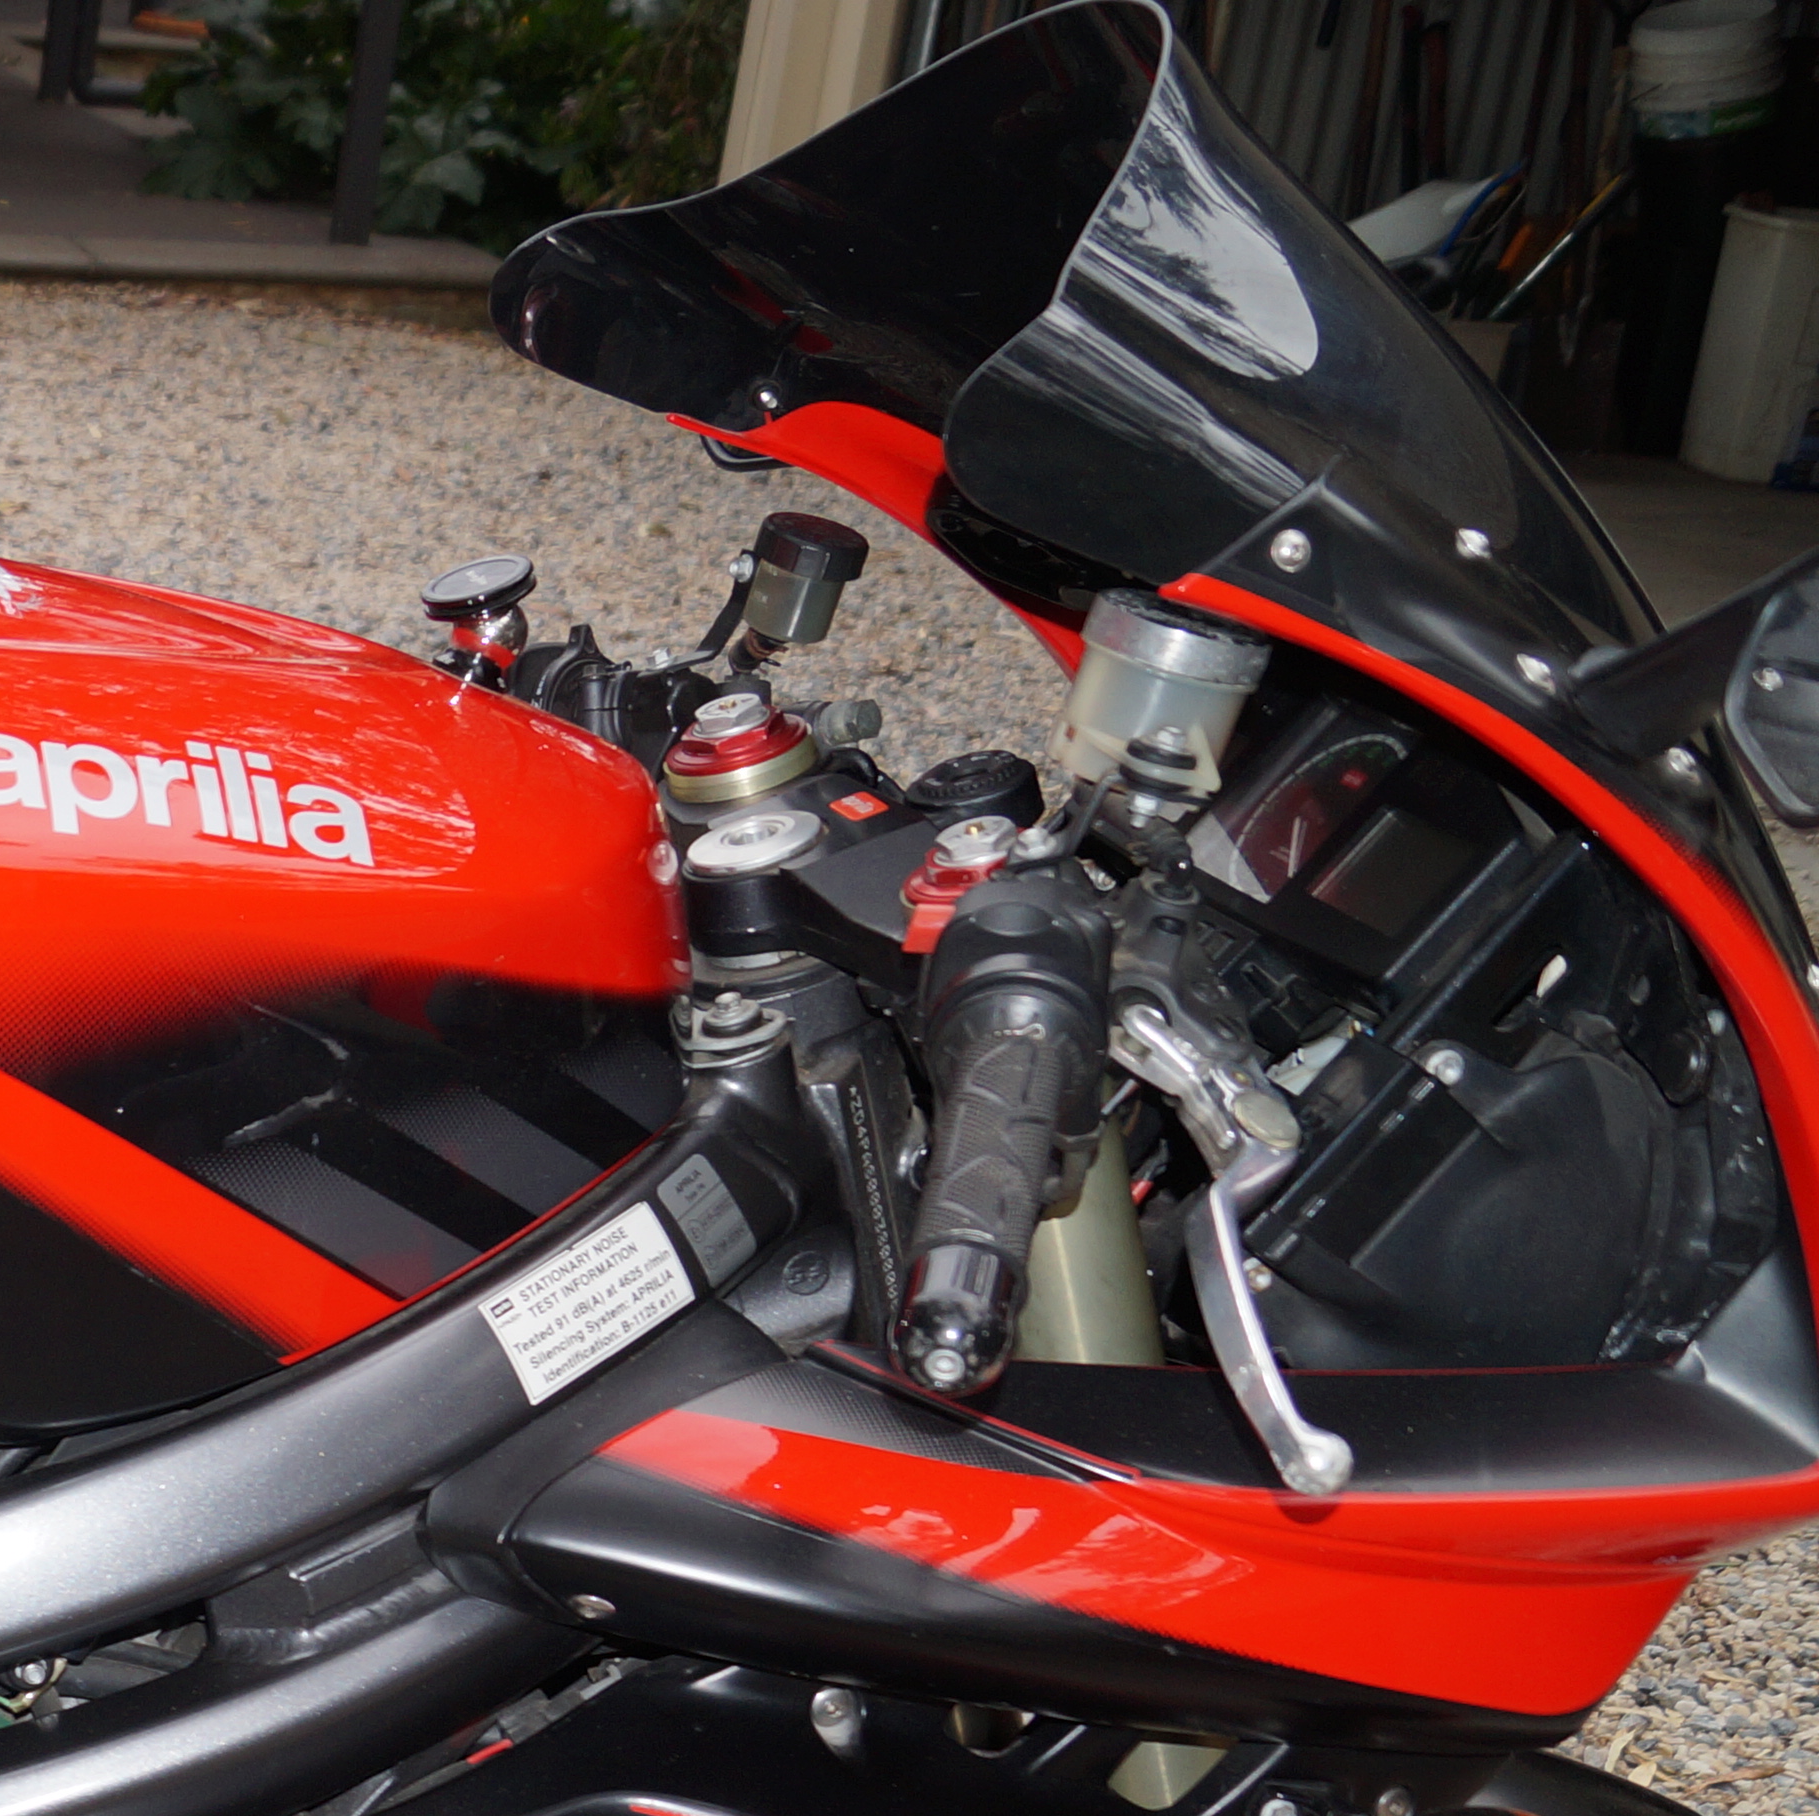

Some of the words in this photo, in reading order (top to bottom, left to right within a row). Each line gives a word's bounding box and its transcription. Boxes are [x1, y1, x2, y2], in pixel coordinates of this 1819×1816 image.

[518, 1251, 592, 1303] STATIONARY
[594, 1227, 628, 1255] NOISE
[529, 1292, 561, 1318] TEST
[560, 1242, 639, 1298] INFORMATION
[513, 1322, 556, 1356] Tested
[556, 1314, 570, 1330] 91
[569, 1290, 607, 1321] dB(A)
[606, 1284, 617, 1297] at
[529, 1328, 587, 1370] Silencing
[631, 1269, 674, 1305] APRILIA
